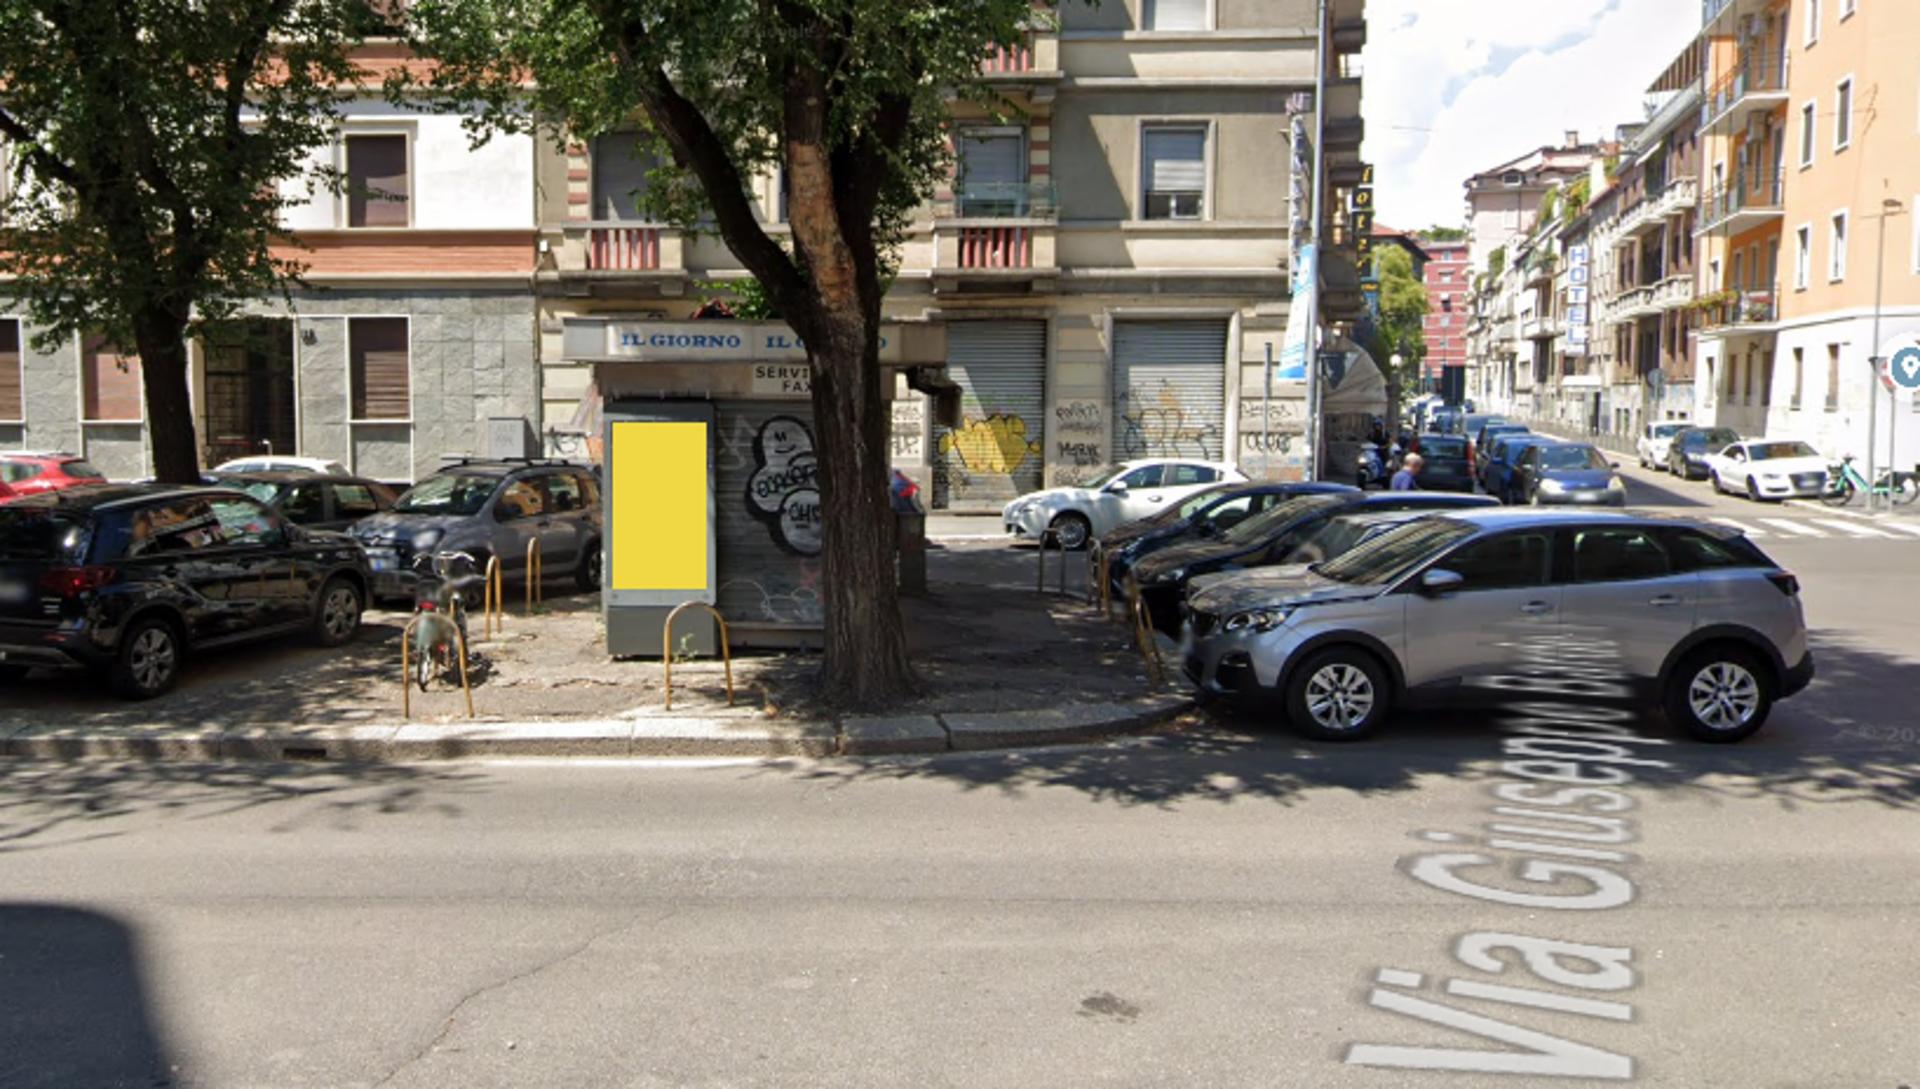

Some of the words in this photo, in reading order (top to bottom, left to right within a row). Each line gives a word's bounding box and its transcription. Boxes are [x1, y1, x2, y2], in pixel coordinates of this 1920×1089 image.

[1568, 249, 1586, 343] HOTEL
[622, 333, 646, 346] IL
[650, 334, 742, 348] GIORNO
[765, 336, 791, 348] IL
[755, 366, 810, 379] SERVI
